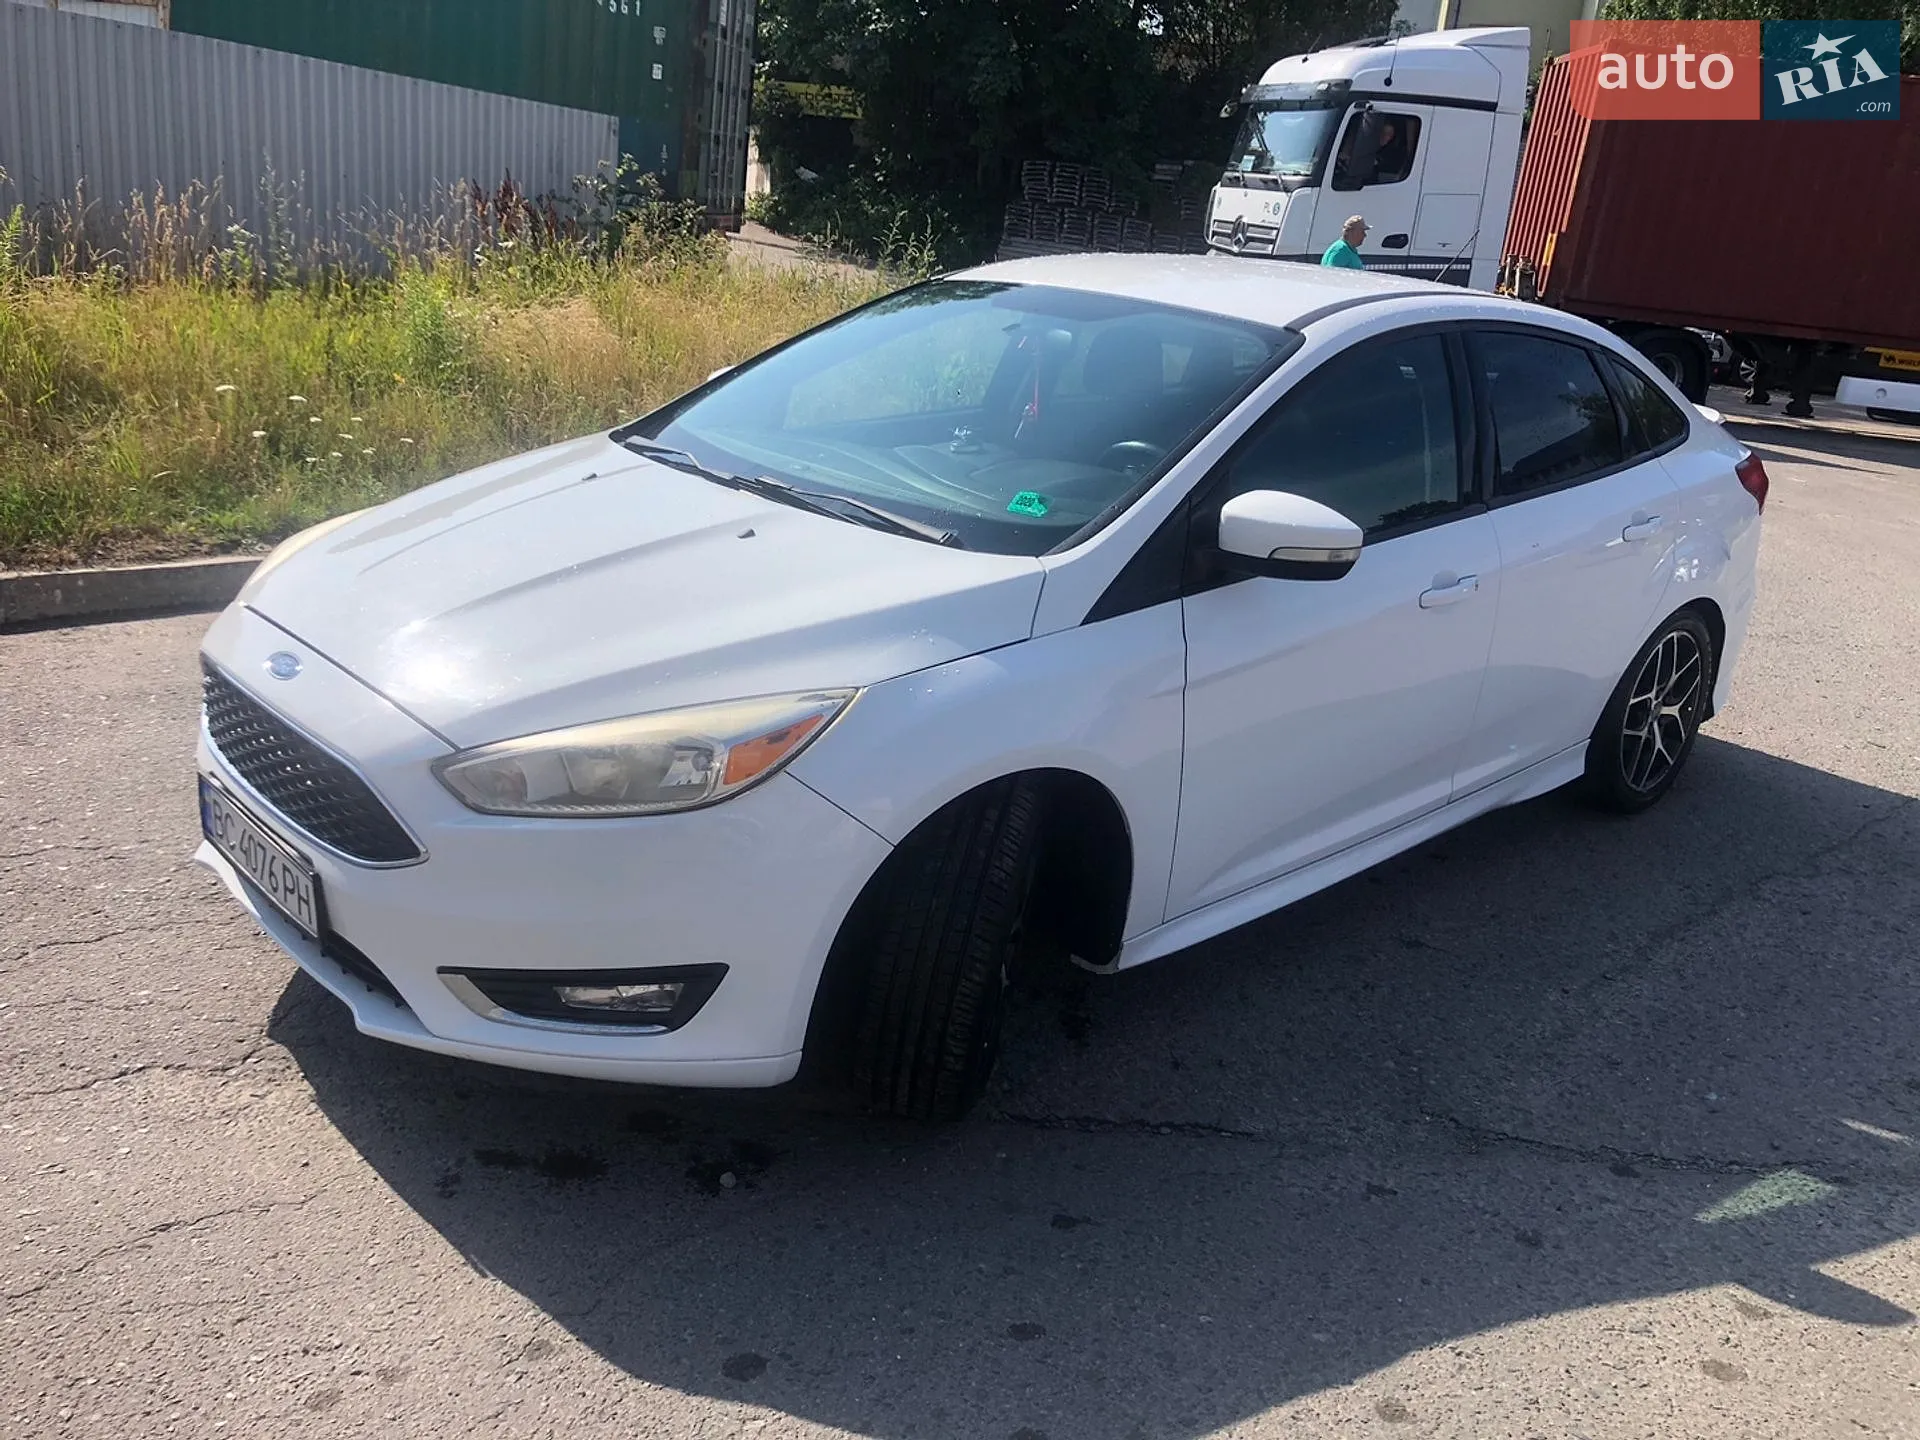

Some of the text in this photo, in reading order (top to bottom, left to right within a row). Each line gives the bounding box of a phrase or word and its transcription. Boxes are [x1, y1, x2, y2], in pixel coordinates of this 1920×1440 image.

[213, 800, 312, 925] BC 4076 PH
